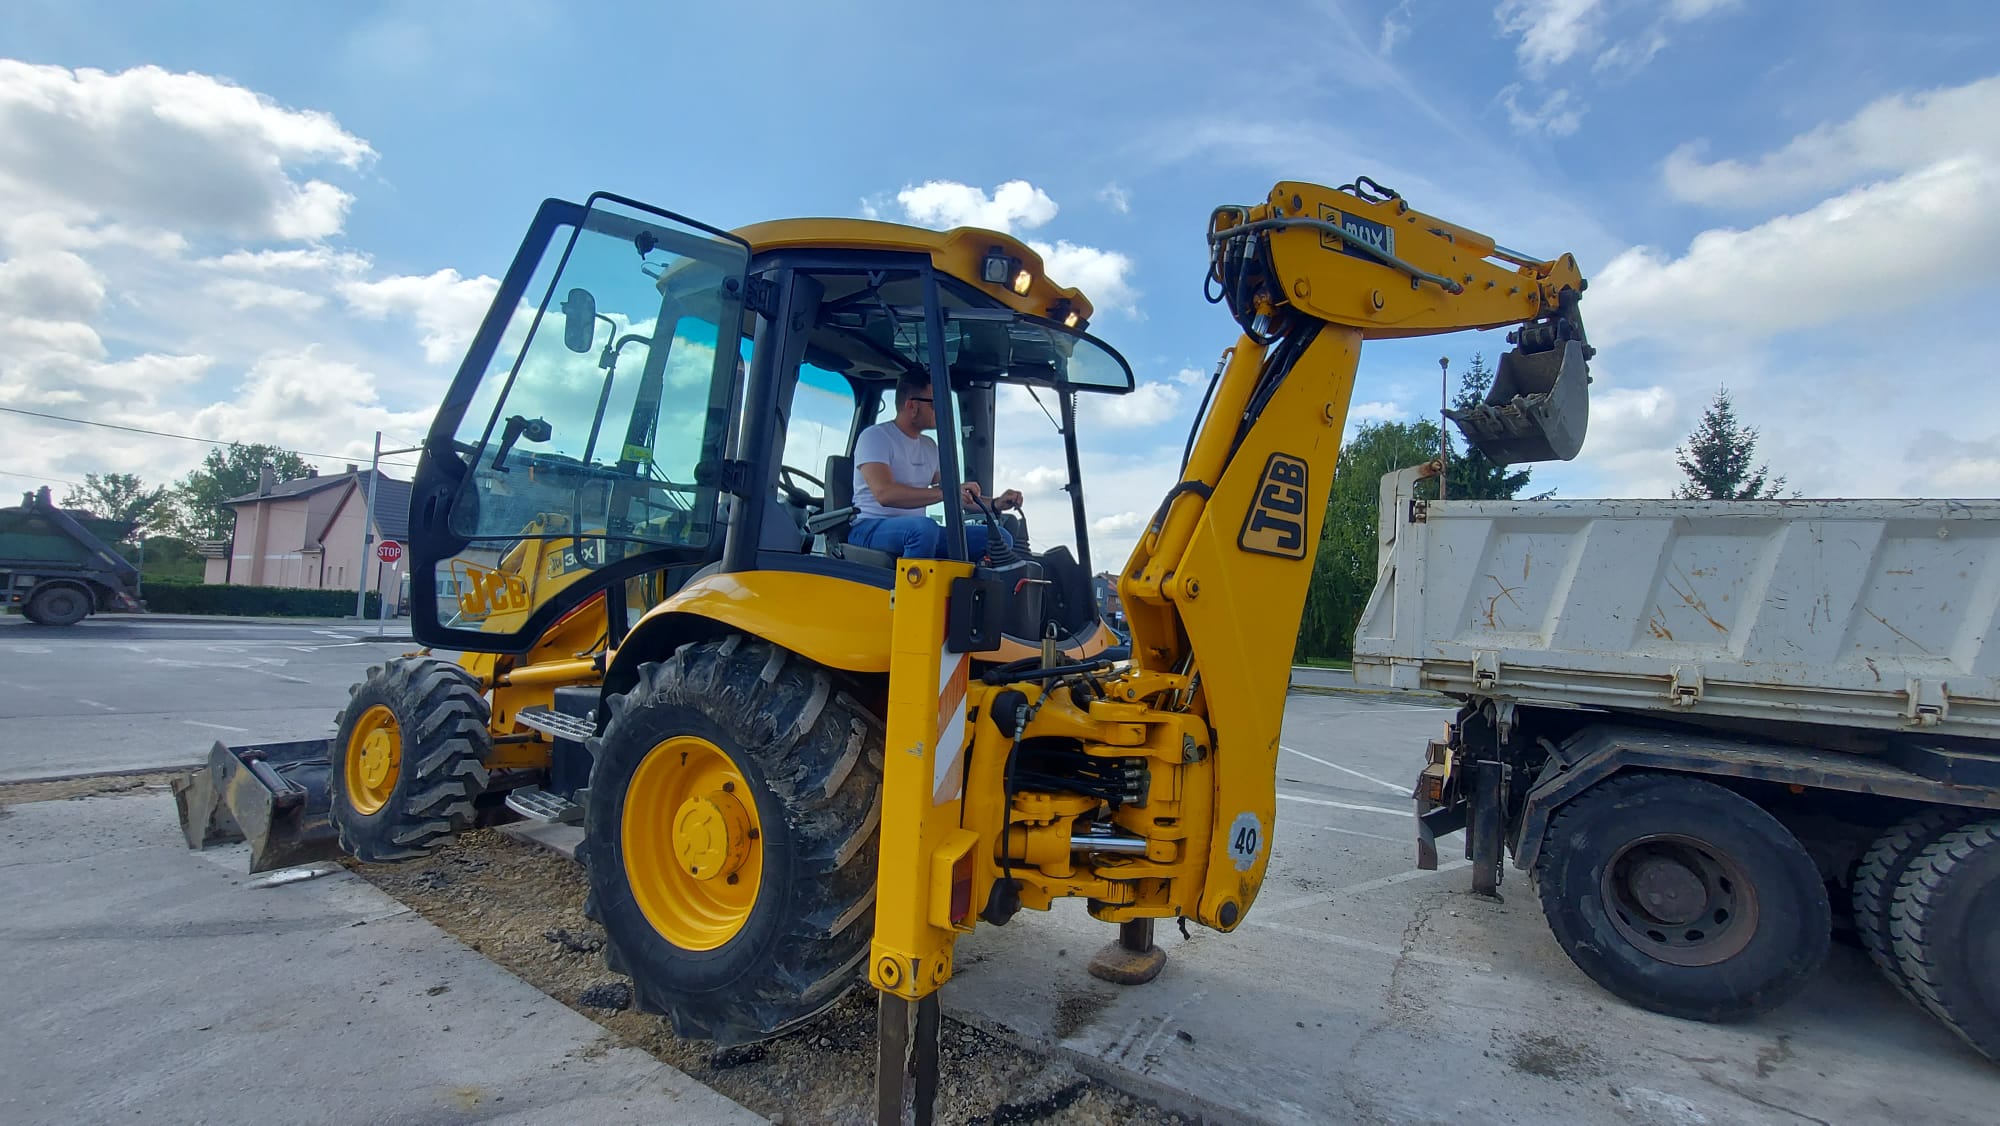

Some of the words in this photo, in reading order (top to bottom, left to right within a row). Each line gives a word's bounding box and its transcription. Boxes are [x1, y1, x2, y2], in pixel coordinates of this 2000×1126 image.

[1250, 461, 1304, 550] JCB
[378, 546, 401, 557] STOP
[464, 568, 526, 614] JCB
[1234, 827, 1257, 855] 40
